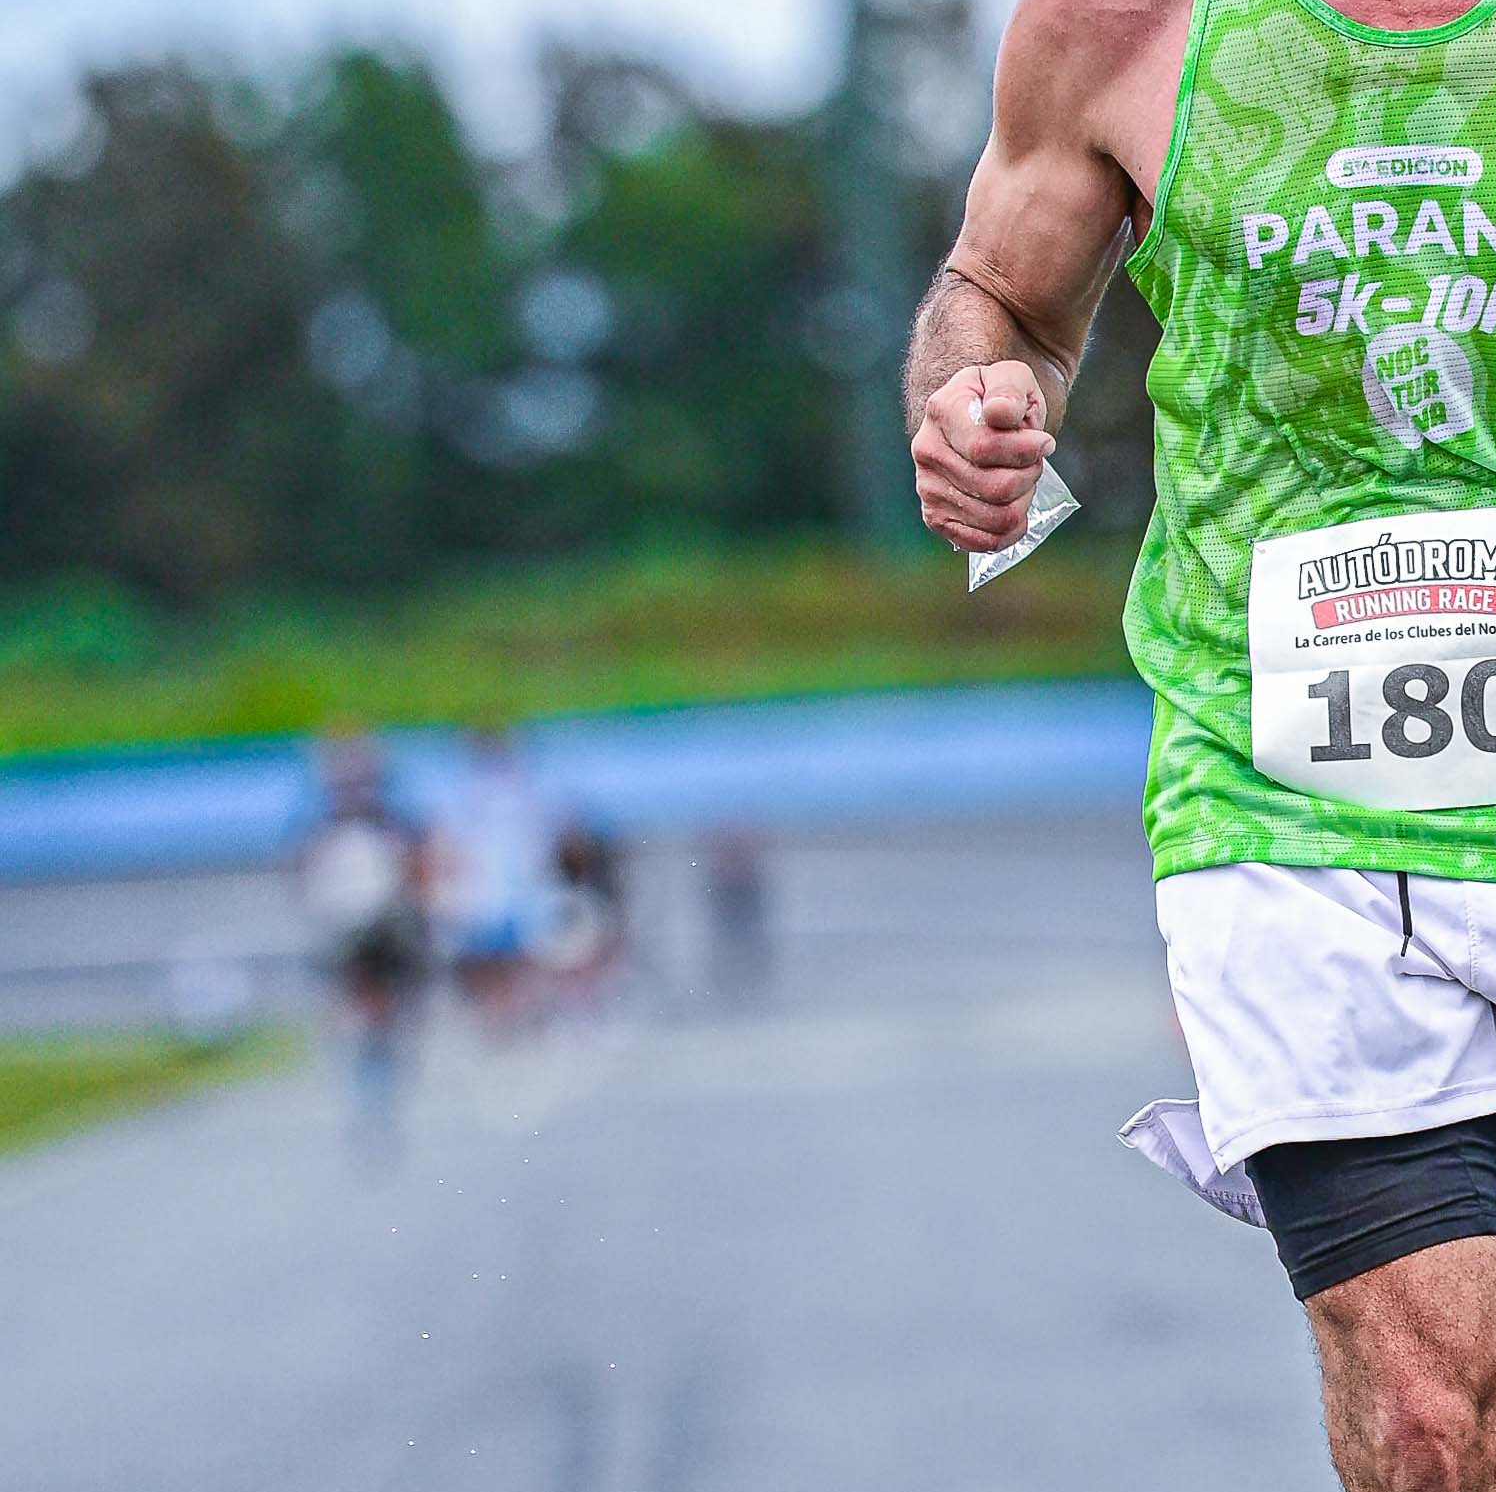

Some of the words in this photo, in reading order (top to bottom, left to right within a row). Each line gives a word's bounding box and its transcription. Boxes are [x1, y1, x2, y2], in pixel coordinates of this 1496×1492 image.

[1376, 154, 1468, 176] EDICIÓN
[1334, 588, 1432, 623] RUNNING
[1438, 588, 1495, 612] RACE
[1295, 636, 1310, 649] La
[1313, 633, 1362, 647] Carrera
[1365, 629, 1381, 642] de
[1385, 628, 1404, 640] los
[1407, 625, 1452, 639] Clubes
[1455, 623, 1476, 636] del
